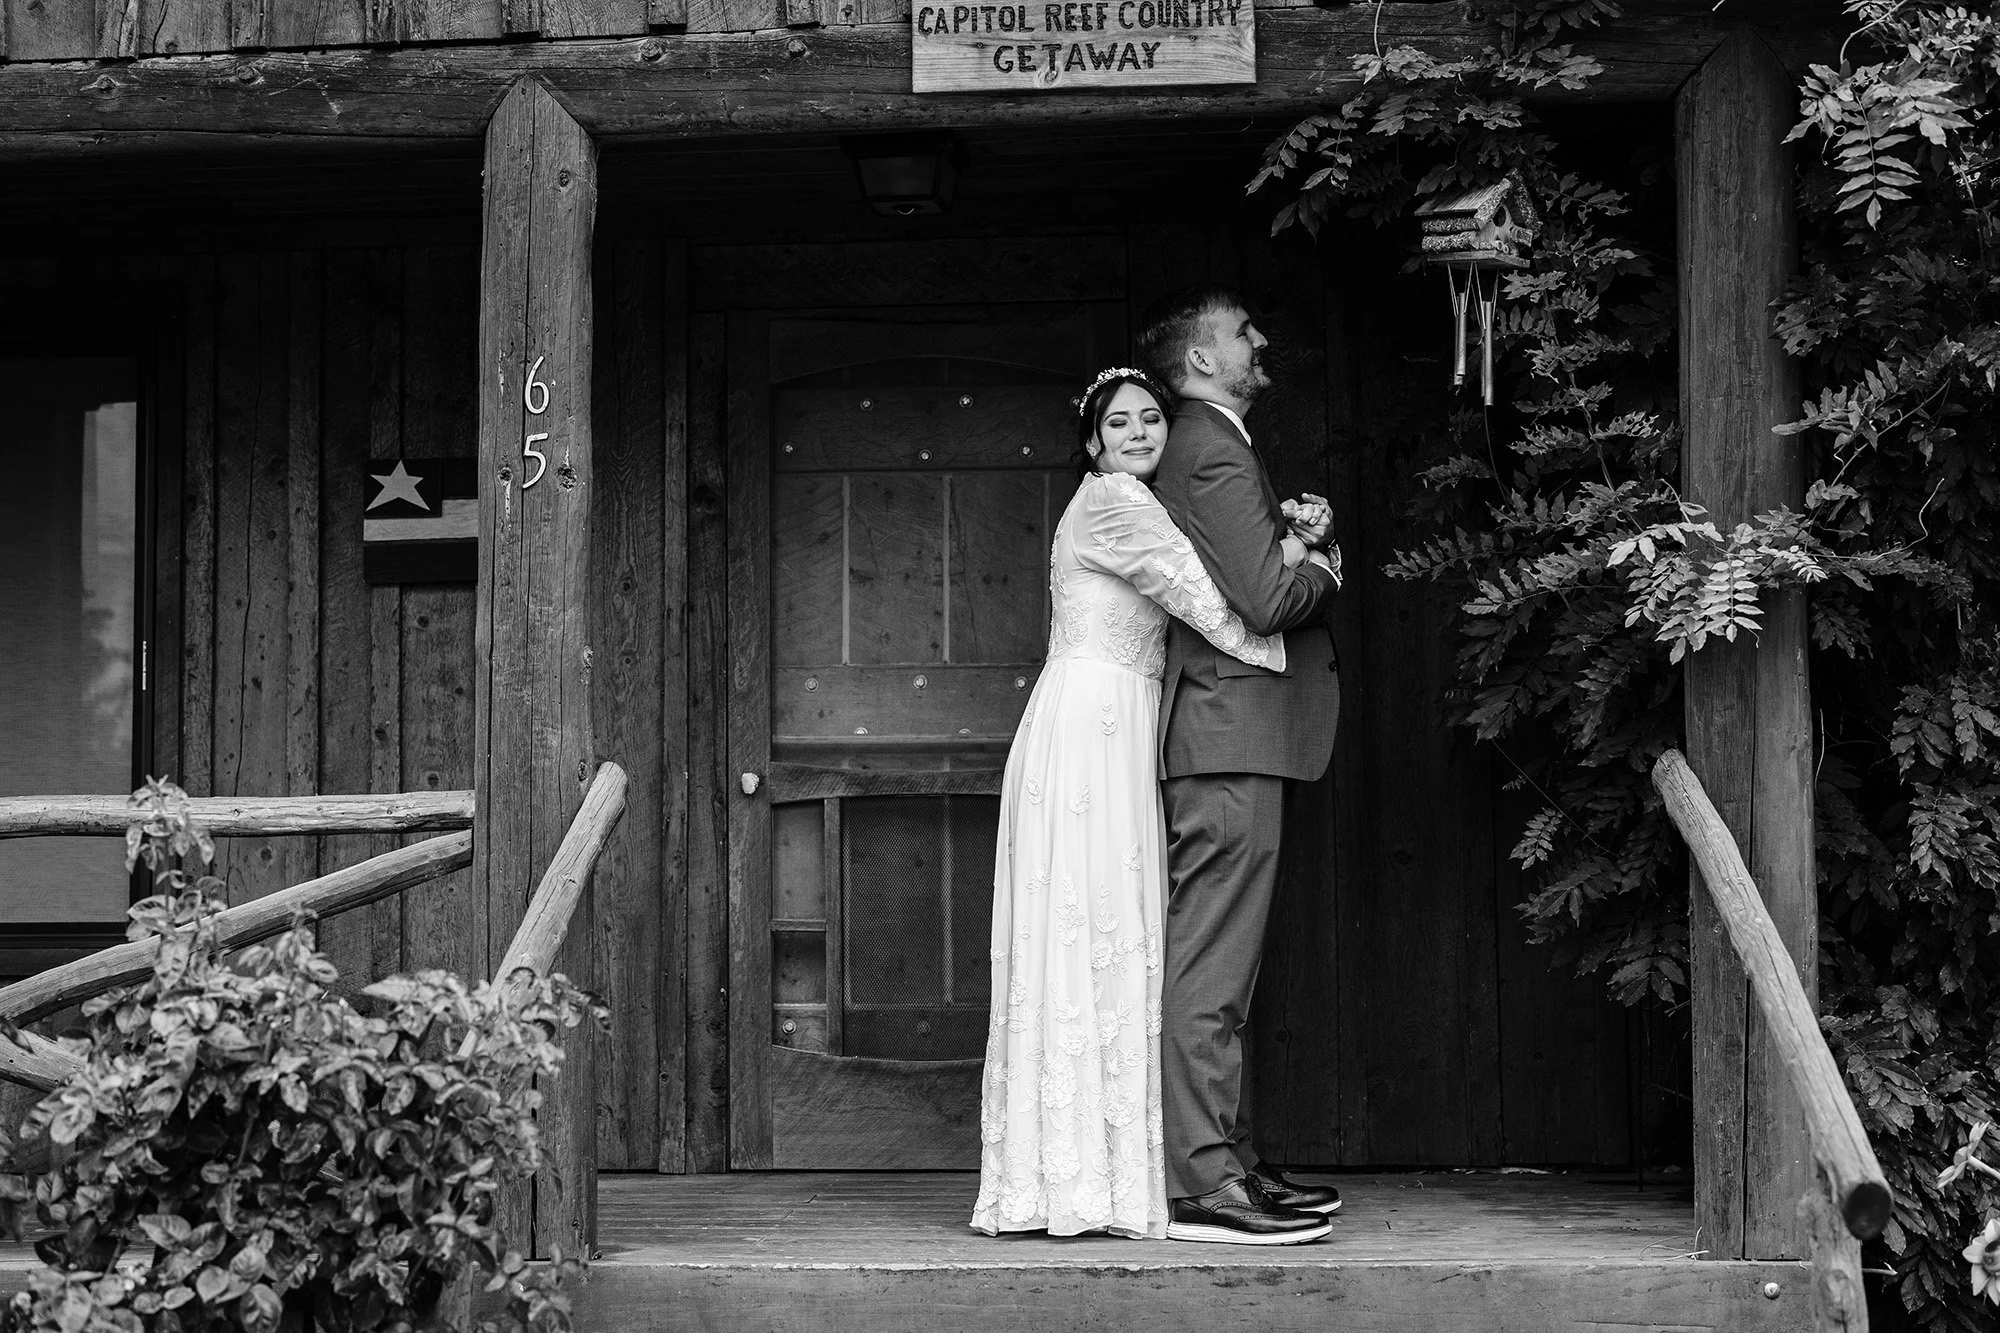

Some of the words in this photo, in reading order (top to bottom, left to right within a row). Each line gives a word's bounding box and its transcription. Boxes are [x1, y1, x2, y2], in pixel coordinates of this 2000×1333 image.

[918, 5, 1035, 35] CAPITOL
[1045, 3, 1108, 32] REEF
[1118, 0, 1241, 29] COUNTRY
[993, 42, 1161, 73] GETAWAY
